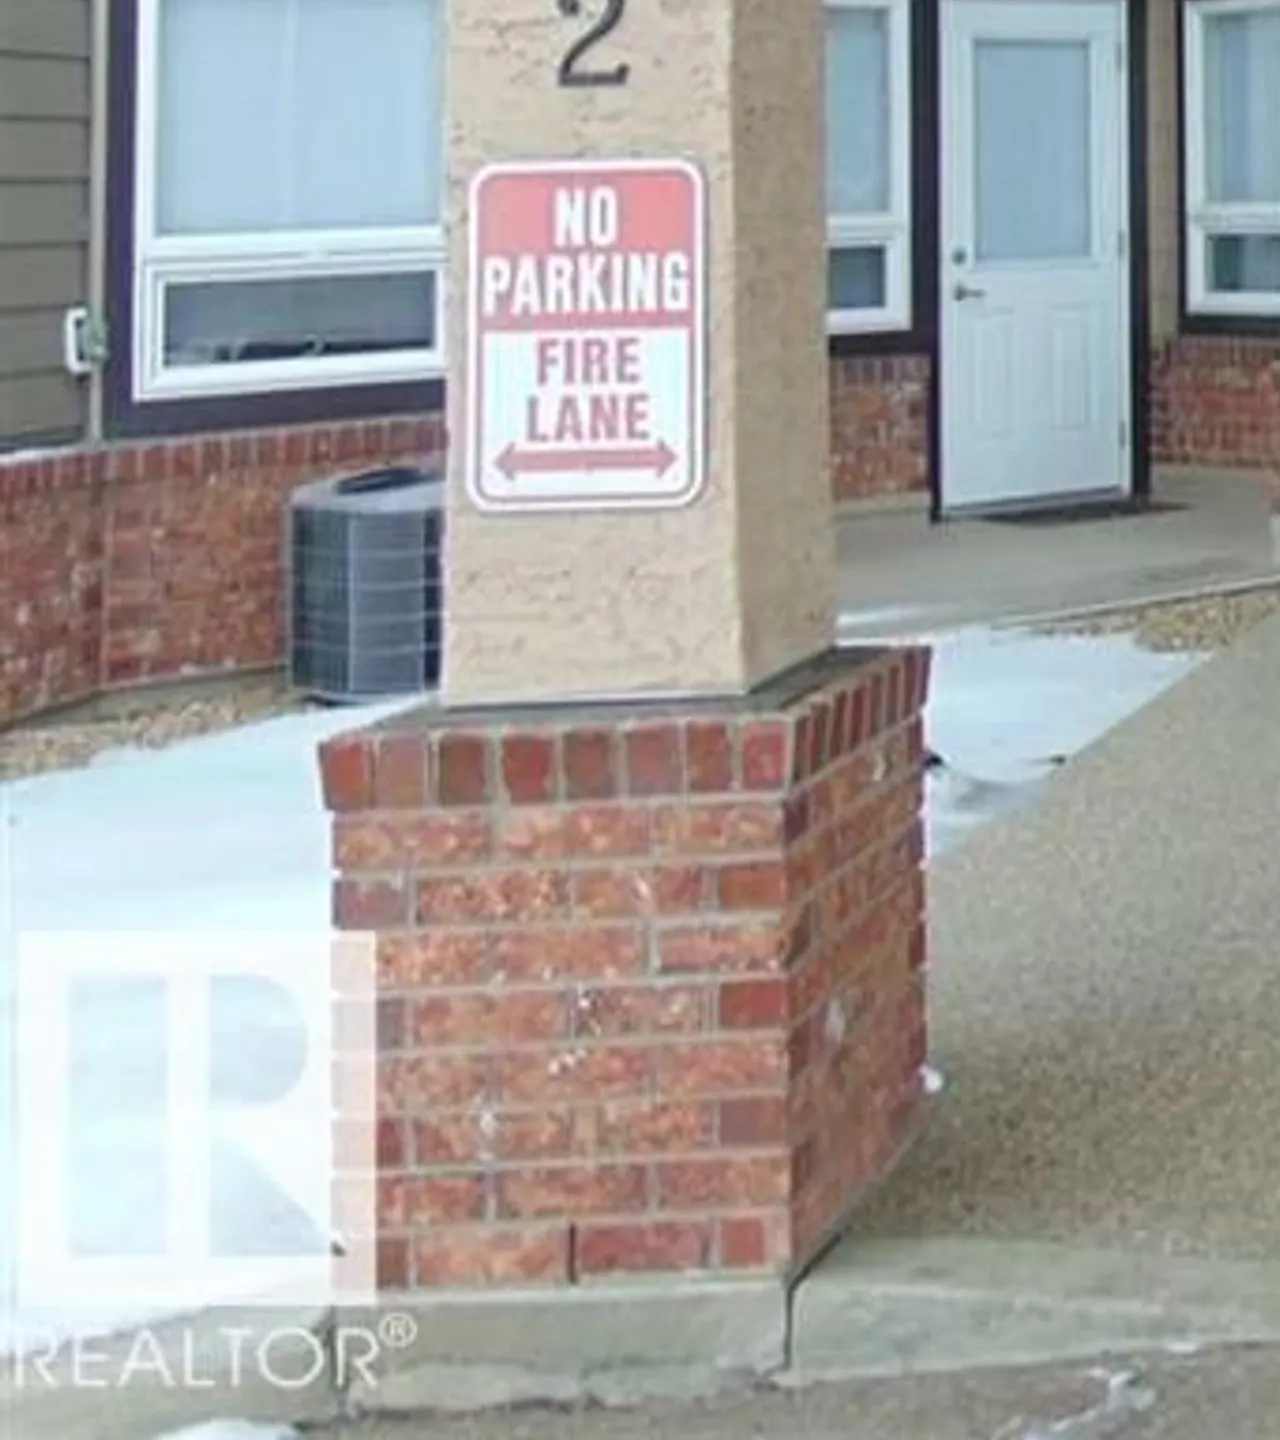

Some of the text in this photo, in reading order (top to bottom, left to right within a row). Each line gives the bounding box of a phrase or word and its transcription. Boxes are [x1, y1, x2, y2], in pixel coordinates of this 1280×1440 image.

[554, 186, 618, 248] NO
[481, 250, 691, 317] PARKING
[536, 336, 642, 387] FIRE
[525, 392, 651, 443] LANE
